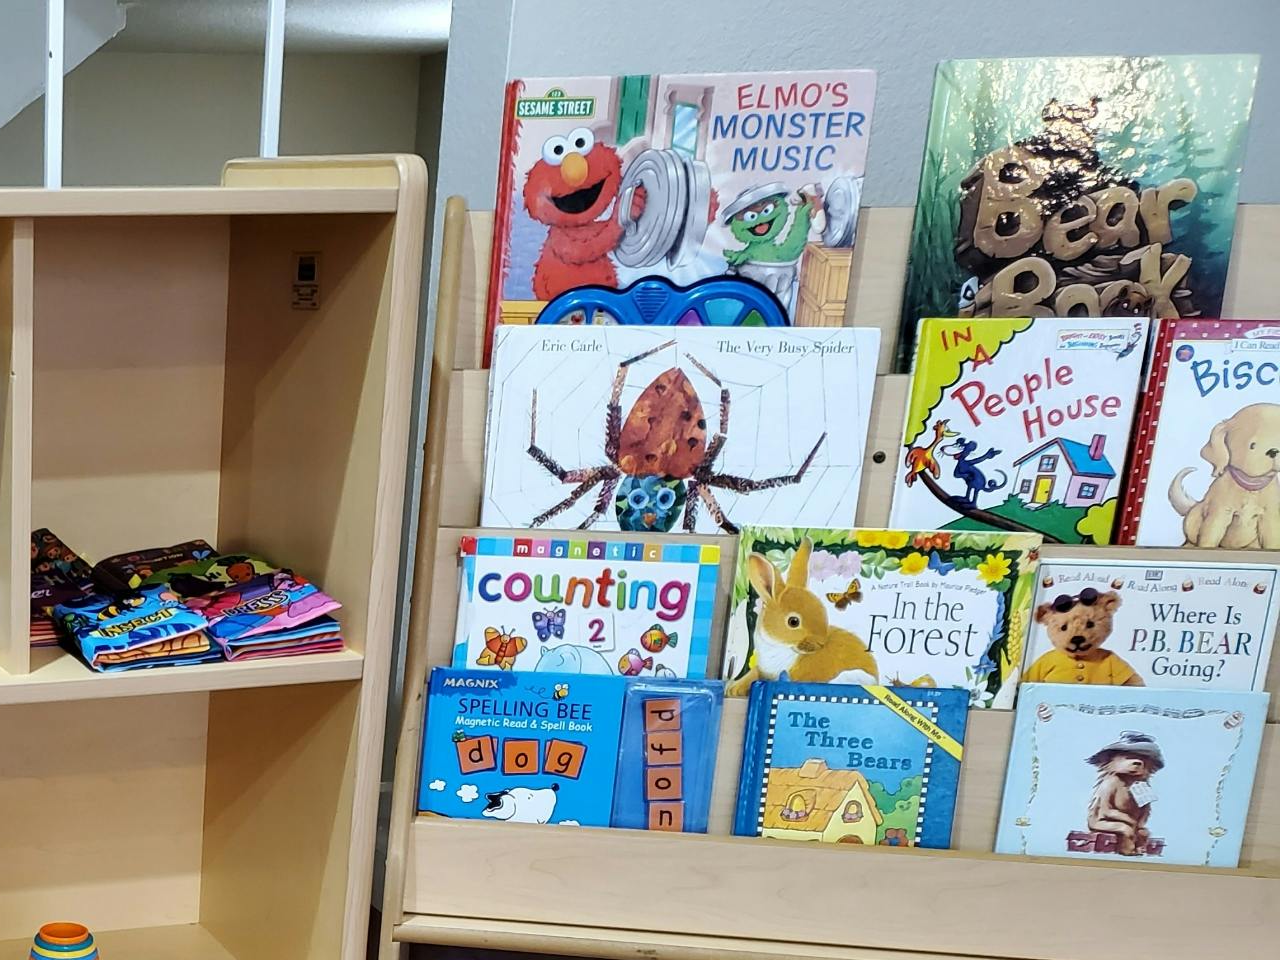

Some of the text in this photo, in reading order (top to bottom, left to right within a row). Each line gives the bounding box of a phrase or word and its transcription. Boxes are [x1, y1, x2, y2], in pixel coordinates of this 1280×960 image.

[518, 100, 593, 116] SESAME STREET
[736, 81, 849, 111] ELMO'S
[712, 110, 867, 142] MONSTER
[732, 144, 836, 172] MUSIC
[973, 145, 1199, 260] Bear
[541, 338, 603, 353] Eric Carle
[716, 340, 855, 358] The Very Busy Spider
[940, 326, 973, 352] IN
[1240, 341, 1257, 349] Can
[970, 343, 995, 373] A
[950, 357, 1075, 428] People
[1021, 394, 1122, 444] House
[517, 543, 659, 559] magnetic
[1058, 574, 1081, 584] Read
[222, 590, 290, 617] DRESS
[477, 567, 691, 622] counting
[891, 591, 964, 622] In the
[98, 608, 174, 639] INSECT
[1149, 603, 1243, 626] Where Is
[588, 618, 605, 644] 2
[864, 614, 979, 658] Forest
[1128, 628, 1253, 657] P.B. BEAR
[1151, 656, 1226, 683] Going?
[443, 677, 500, 689] MAGNIX
[457, 697, 593, 721] SPELLING BEE
[787, 711, 831, 729] The
[884, 694, 942, 740] Read Along With Me
[455, 715, 593, 732] Magnetic Read & Spell Book
[804, 730, 874, 750] Three
[846, 751, 913, 771] Bears
